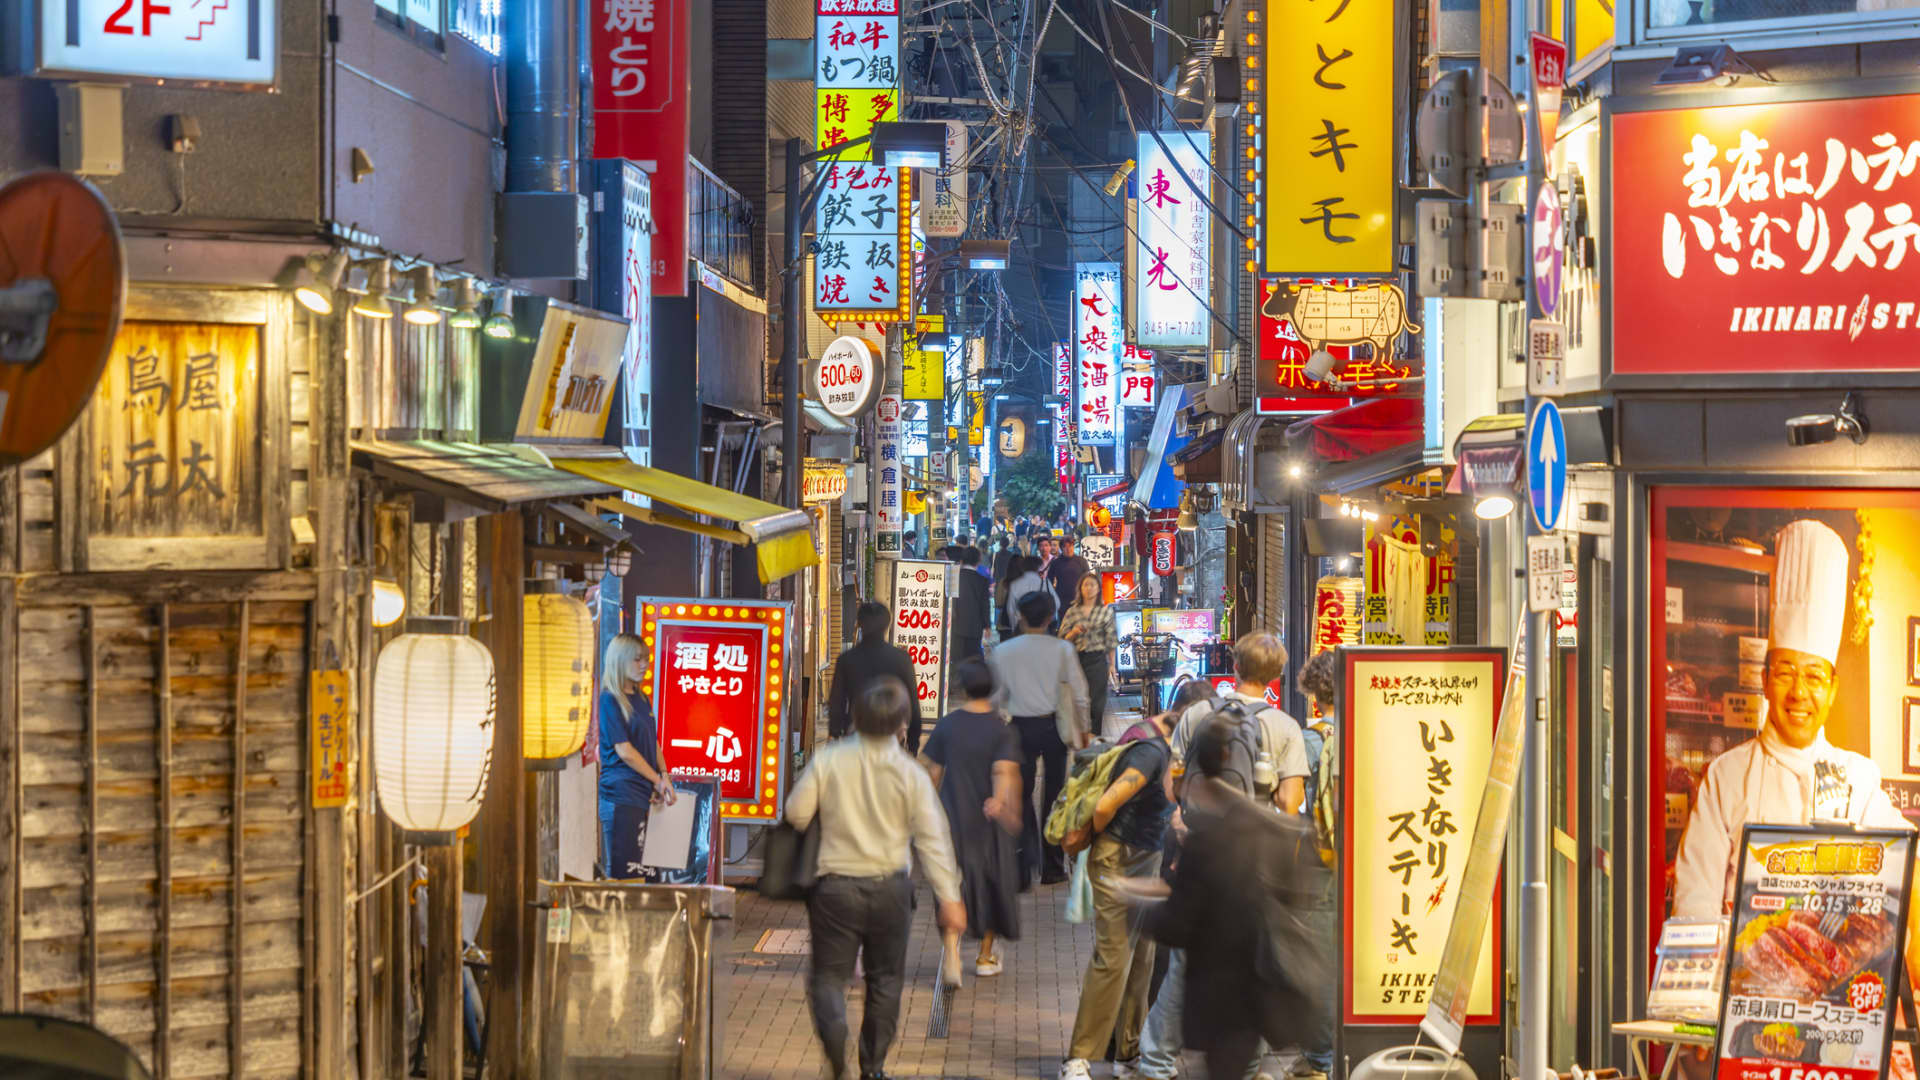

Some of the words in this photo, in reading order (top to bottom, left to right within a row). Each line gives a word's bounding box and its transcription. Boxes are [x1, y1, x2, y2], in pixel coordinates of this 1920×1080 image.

[104, 0, 171, 36] 2F
[828, 20, 889, 51] 和牛
[821, 55, 895, 83] もつ鍋
[821, 93, 893, 123] 博多
[1300, 0, 1361, 243] とキモ
[827, 166, 893, 189] 手包み
[821, 194, 896, 229] 餃子
[1144, 168, 1182, 291] 東光
[1662, 201, 1920, 279] いきなりステ
[822, 241, 895, 270] 鉄板
[820, 274, 890, 304] 焼き
[1144, 321, 1203, 336] 3451-7722
[1730, 305, 1847, 333] IKINARI
[1871, 302, 1920, 330] ST
[1080, 293, 1110, 425] 大衆酒場
[1278, 358, 1410, 391] ホモン
[880, 443, 897, 508] 横倉屋
[673, 642, 748, 672] 酒処
[905, 646, 938, 665] 80円
[677, 675, 743, 696] やきとり
[671, 727, 742, 763] 一心
[1419, 720, 1458, 879] いきなり
[1388, 812, 1423, 955] ステーキ
[1860, 896, 1883, 914] 28
[1731, 998, 1882, 1027] 赤身肩ロースステーキ
[1854, 995, 1879, 1009] OFF
